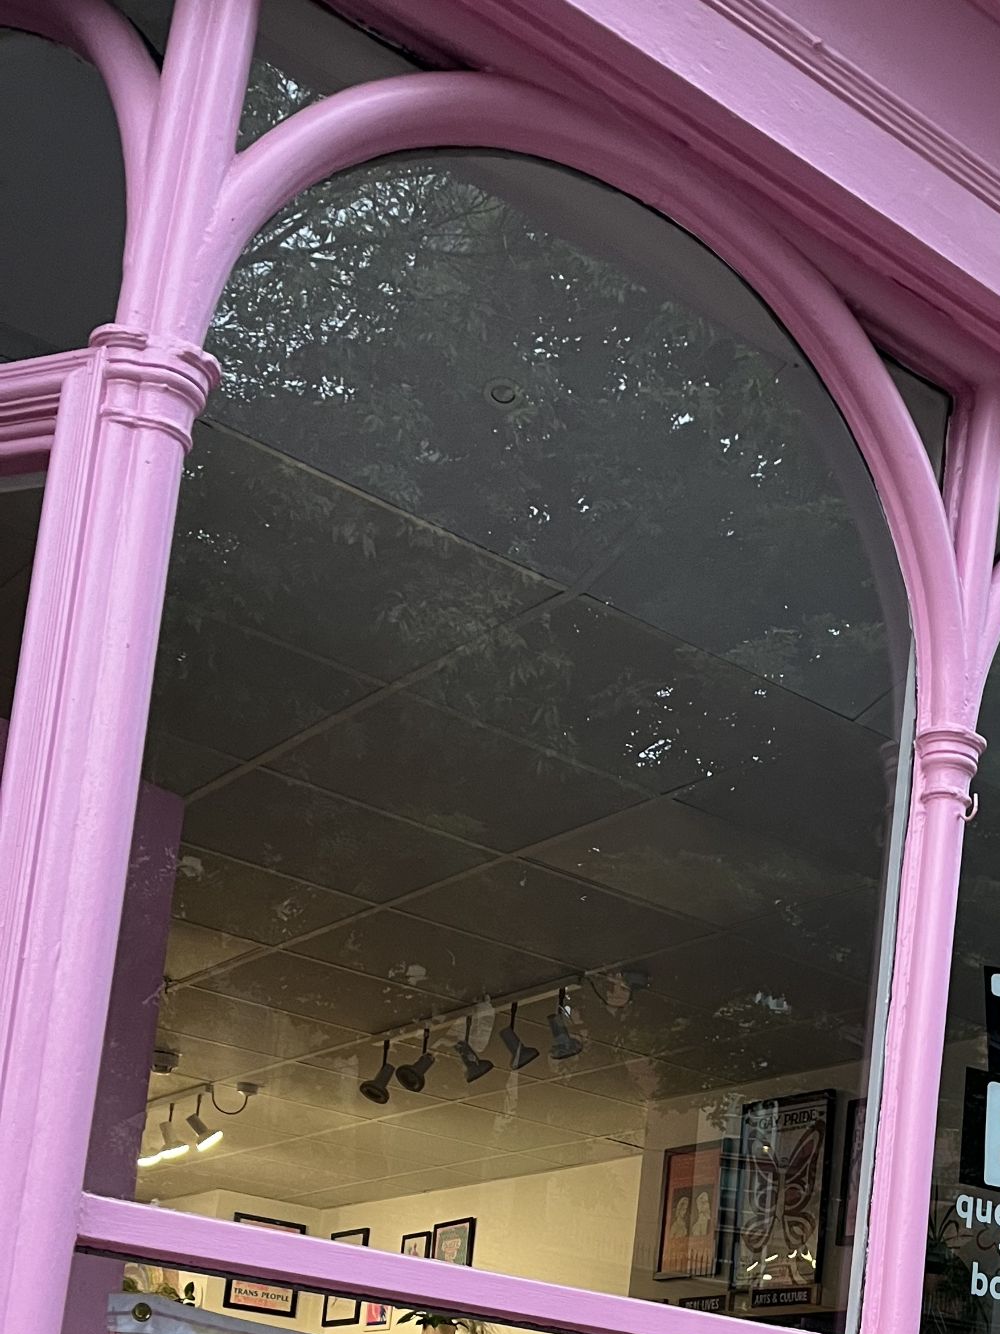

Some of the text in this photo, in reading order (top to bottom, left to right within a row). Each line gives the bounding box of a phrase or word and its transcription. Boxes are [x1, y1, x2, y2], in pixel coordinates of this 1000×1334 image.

[759, 1115, 780, 1130] GAY
[784, 1108, 818, 1126] PRIDE
[233, 1287, 289, 1302] TRANS PEOPLE
[754, 1290, 808, 1305] ARTS & CULTURE
[701, 1298, 720, 1311] LIVES
